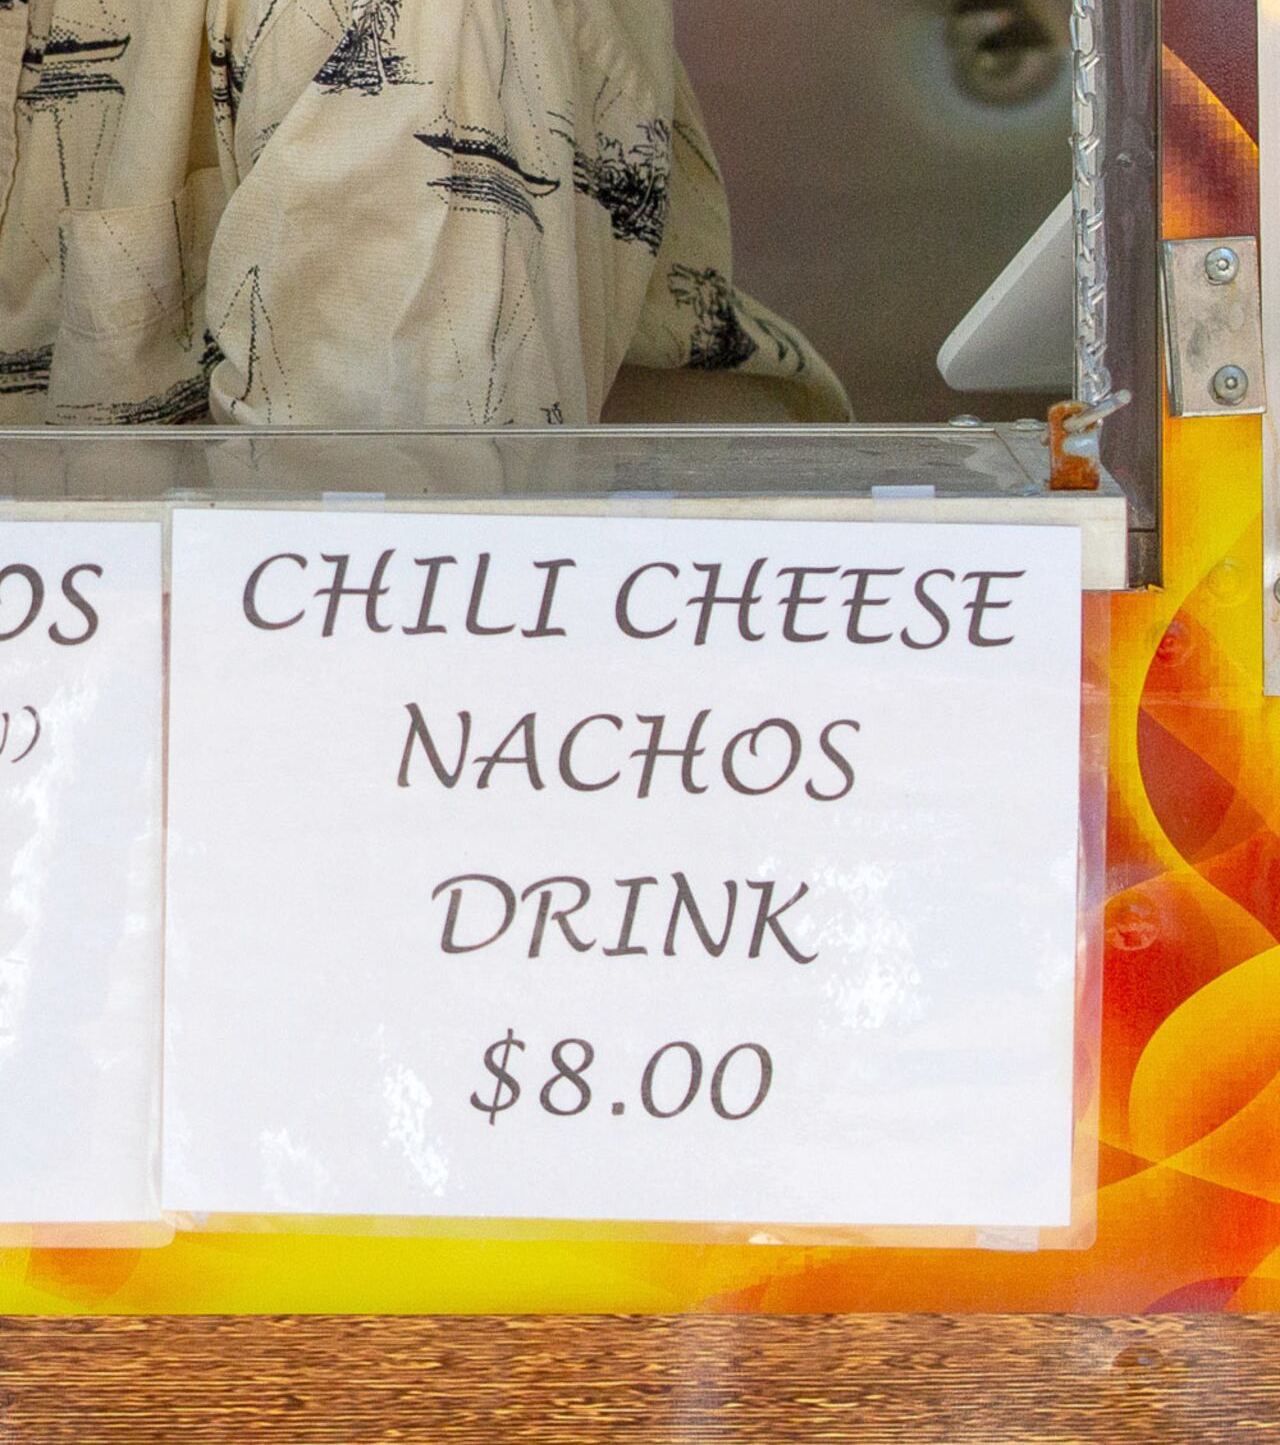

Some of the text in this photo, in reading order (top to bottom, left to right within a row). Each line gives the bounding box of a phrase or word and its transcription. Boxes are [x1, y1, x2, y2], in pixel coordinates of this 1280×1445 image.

[241, 547, 1027, 651] CHILI CHEESE
[396, 701, 862, 803] NACHOS
[430, 870, 820, 966] DRINK
[468, 1027, 774, 1127] $8.00
